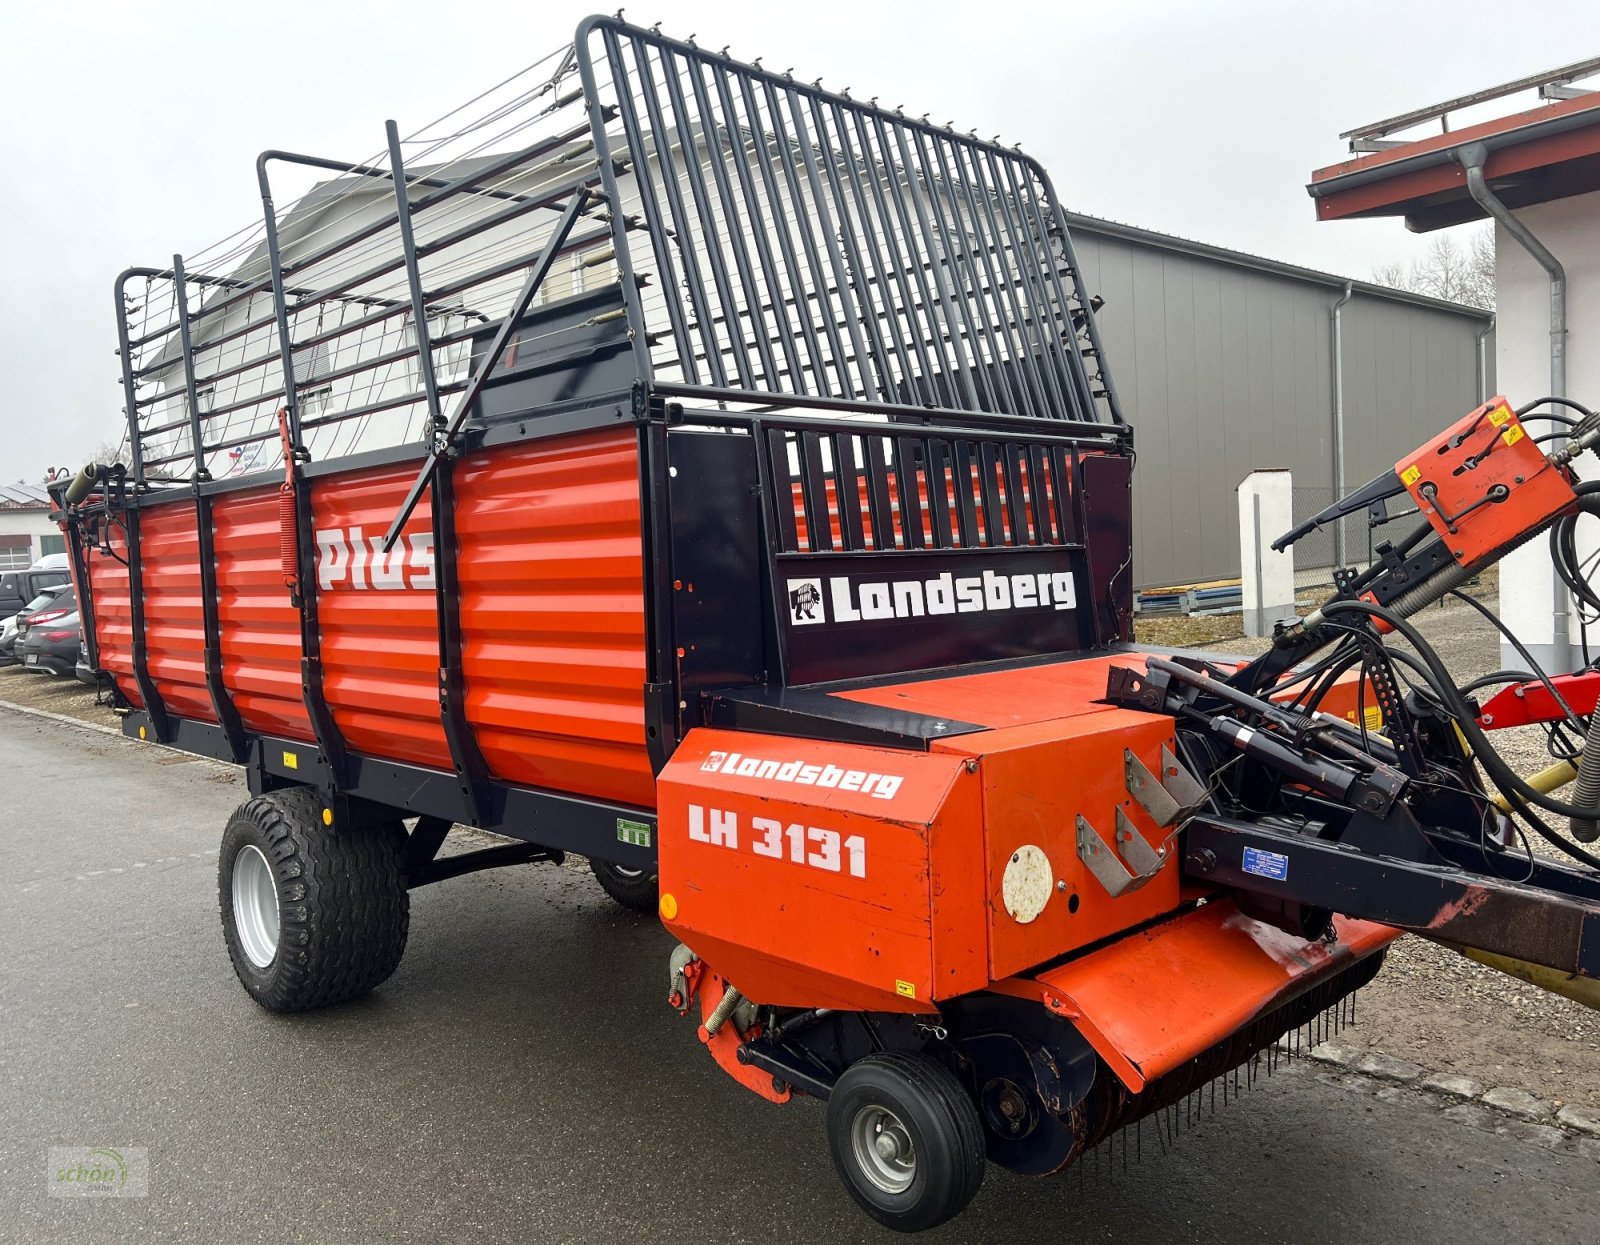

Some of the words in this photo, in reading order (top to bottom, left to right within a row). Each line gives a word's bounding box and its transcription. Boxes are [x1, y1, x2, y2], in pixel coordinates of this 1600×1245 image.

[829, 570, 1077, 623] Landsberg
[720, 753, 904, 800] Landsberg
[688, 804, 738, 849] LH
[752, 816, 866, 879] 3131
